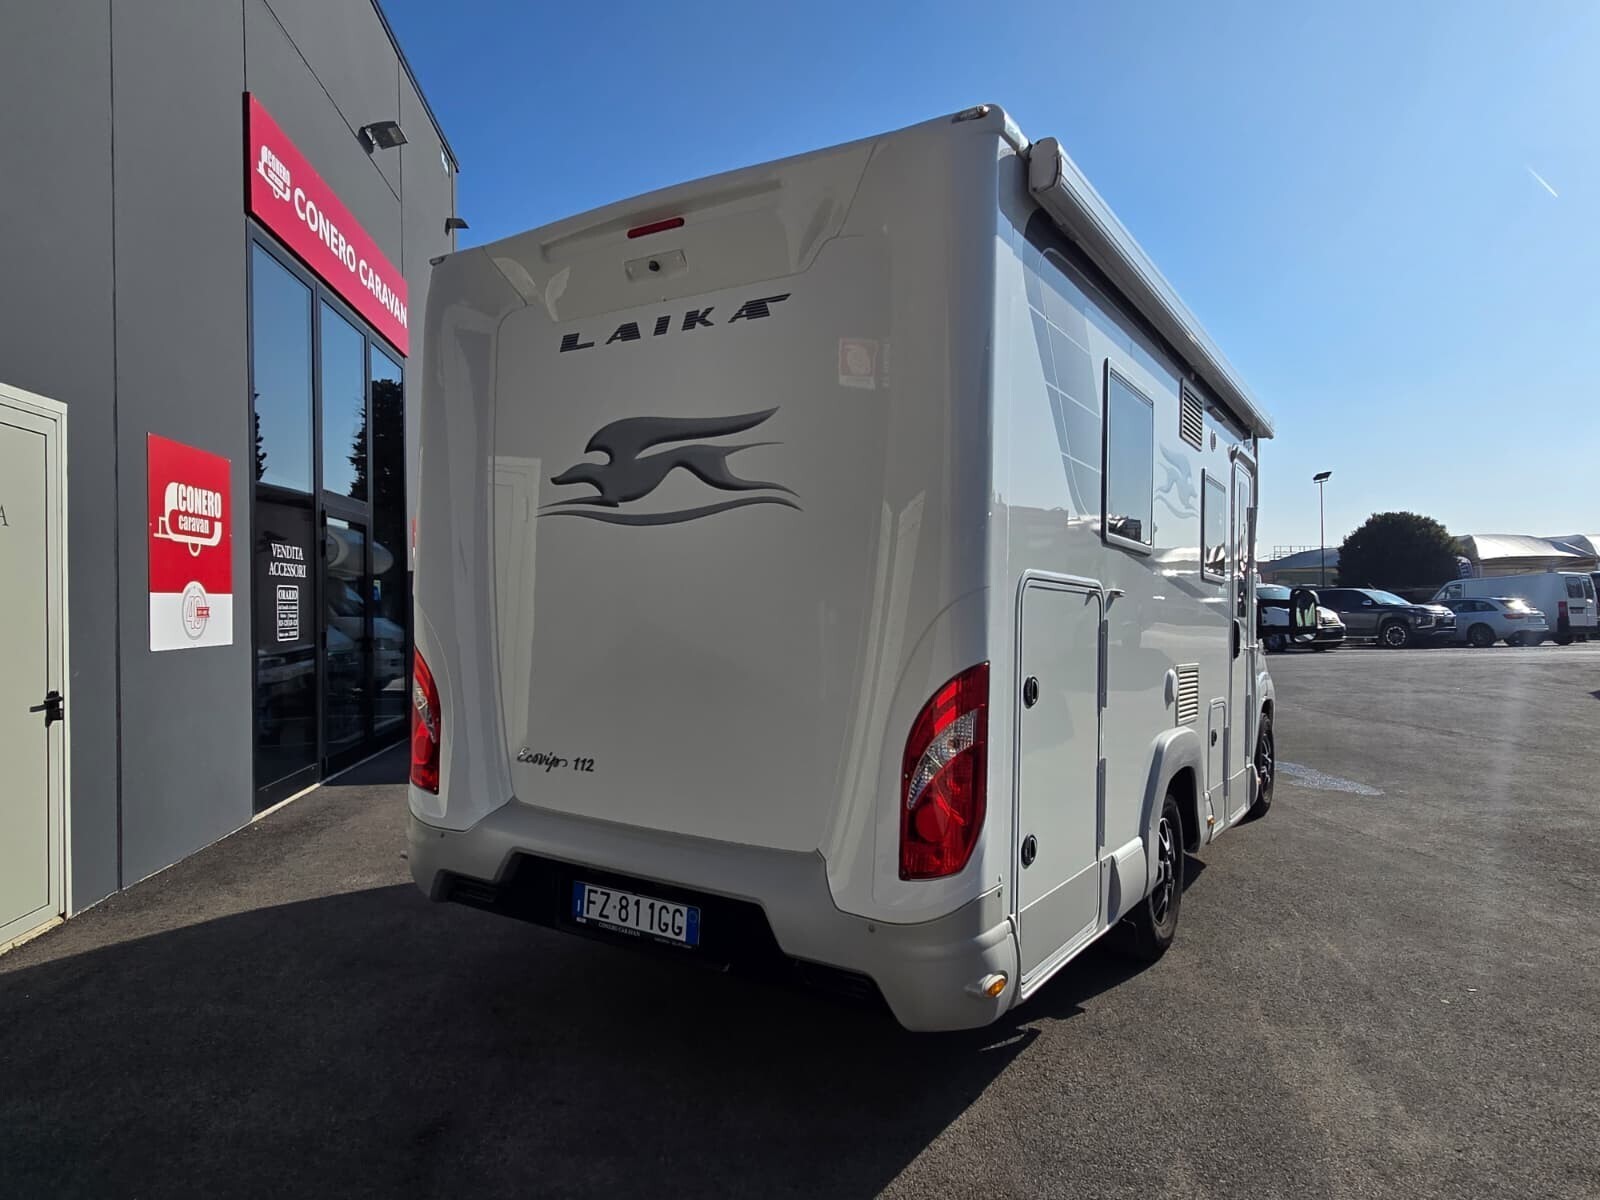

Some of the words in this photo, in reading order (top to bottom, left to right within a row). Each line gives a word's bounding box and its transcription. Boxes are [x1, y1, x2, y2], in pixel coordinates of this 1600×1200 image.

[294, 187, 356, 273] CONERO
[359, 259, 408, 329] CARAVAN
[559, 293, 791, 352] LAIKA
[178, 484, 222, 519] CONERO
[178, 515, 210, 535] caravan
[271, 543, 304, 561] VENDITA
[269, 562, 307, 578] ACCESSORI
[573, 757, 594, 772] 112
